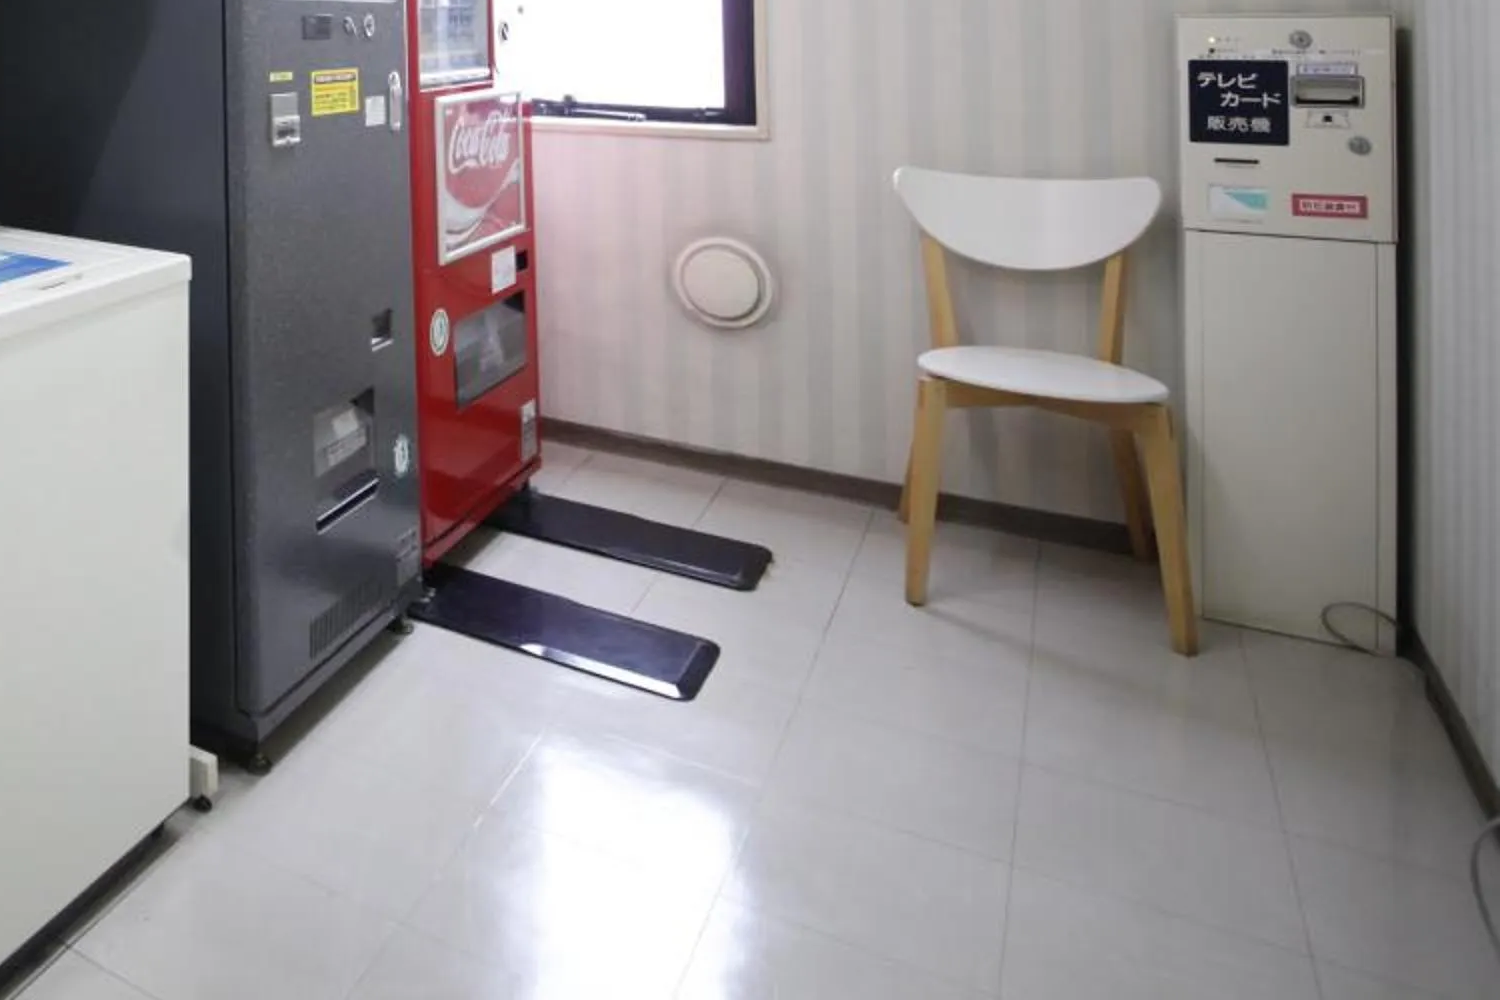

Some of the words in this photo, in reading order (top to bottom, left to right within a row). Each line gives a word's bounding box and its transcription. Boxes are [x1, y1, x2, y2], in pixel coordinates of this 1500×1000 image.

[1197, 72, 1259, 89] テレビ
[1220, 91, 1283, 108] カード
[1206, 115, 1273, 134] 販売機
